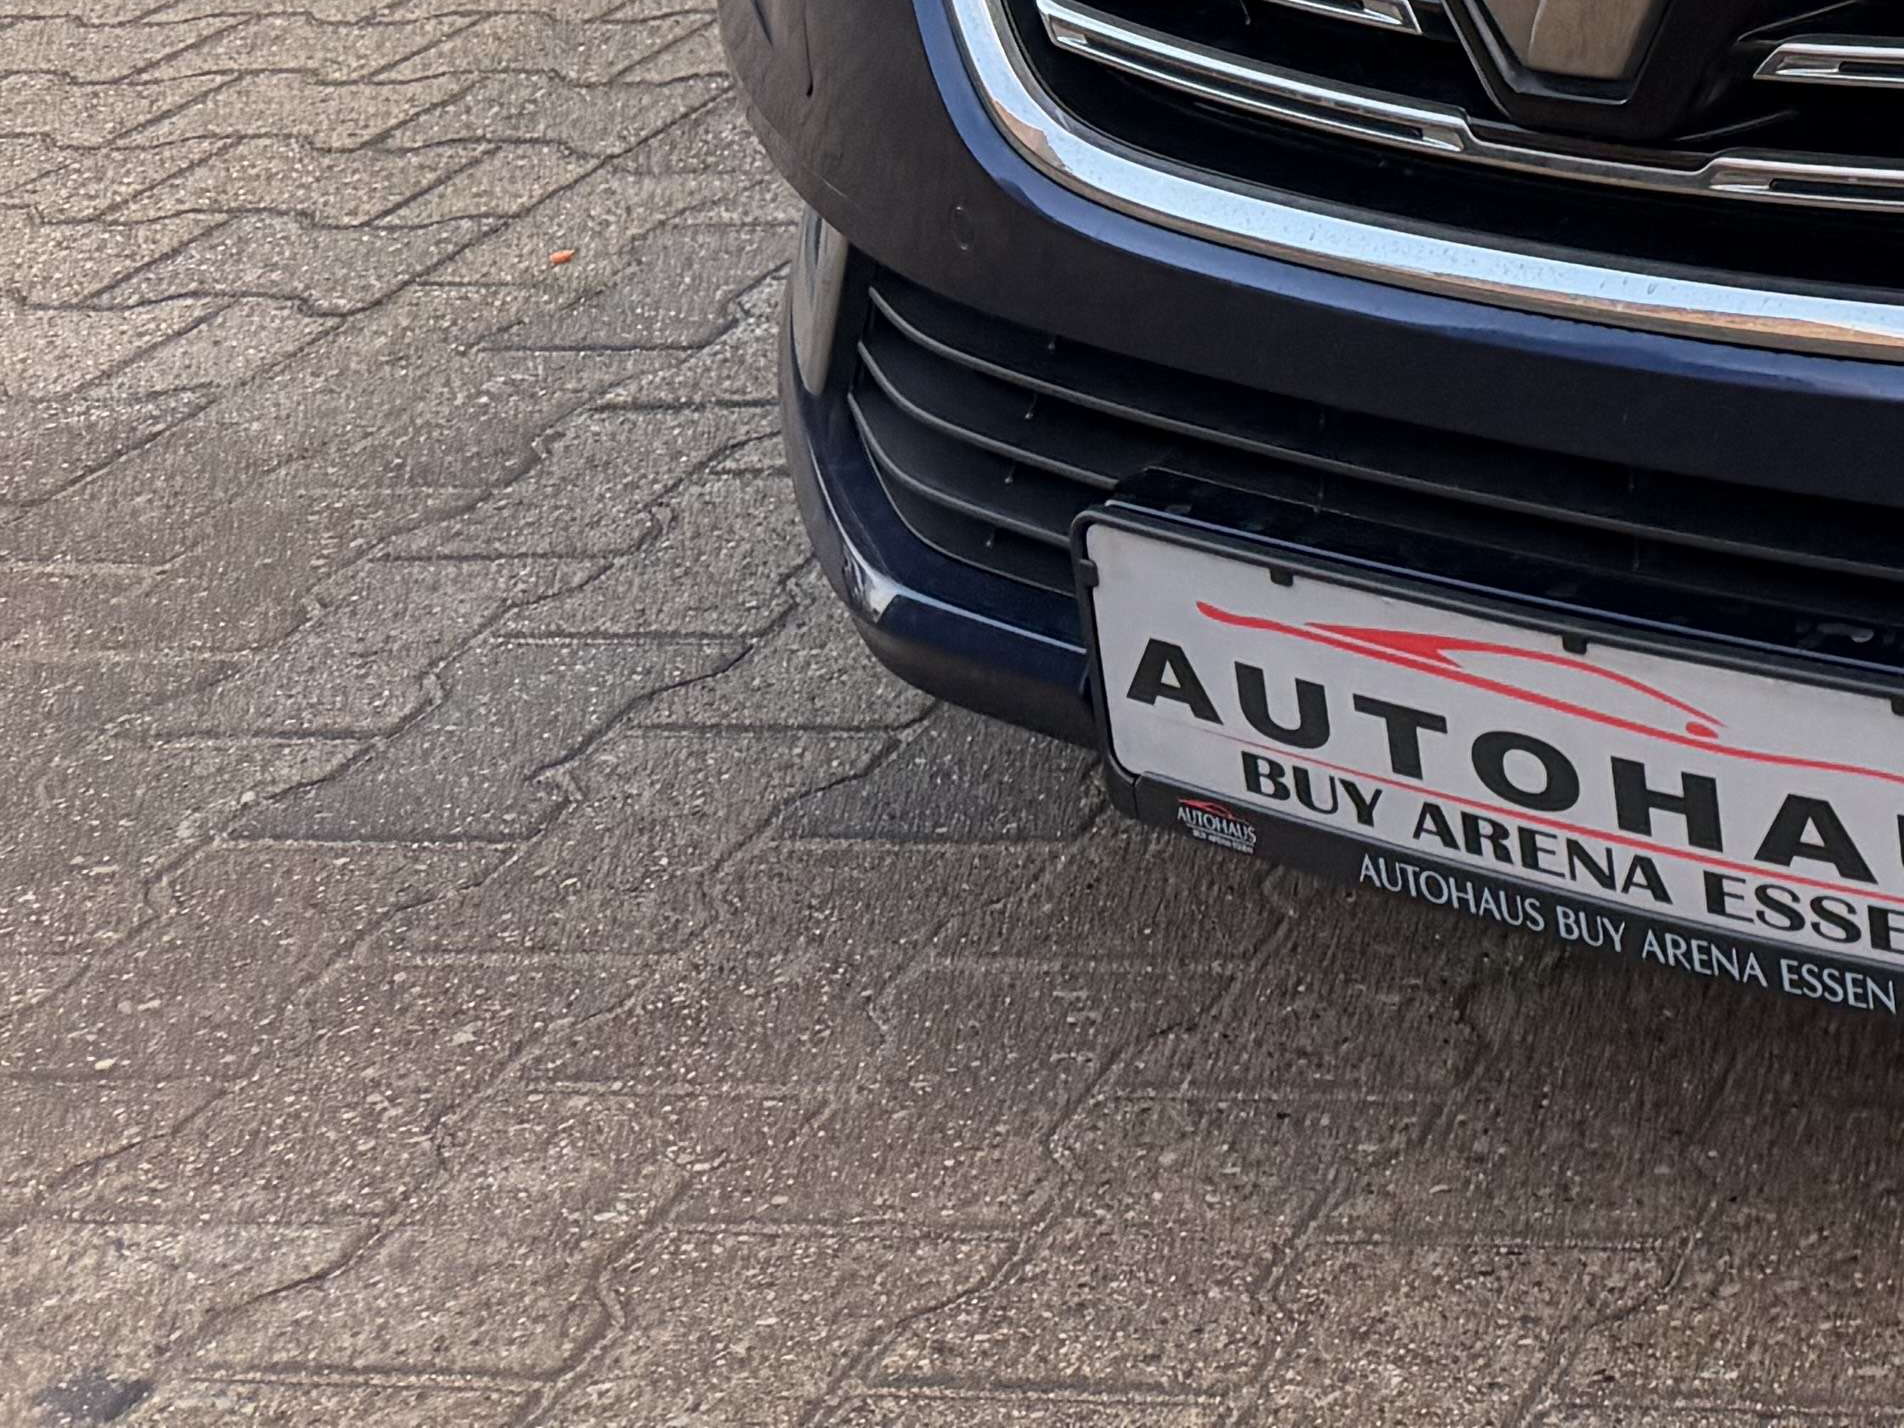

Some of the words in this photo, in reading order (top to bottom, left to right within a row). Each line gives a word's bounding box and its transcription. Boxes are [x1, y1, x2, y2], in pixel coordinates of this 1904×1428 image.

[1177, 805, 1257, 844] AUTOHAUS
[1243, 750, 1384, 828] BUY
[1411, 799, 1673, 907] ARENA
[1358, 852, 1546, 935] AUTOHAUS
[1556, 904, 1627, 956] BUY
[1640, 928, 1768, 986] ARENA
[1780, 958, 1896, 1016] ESSEN
